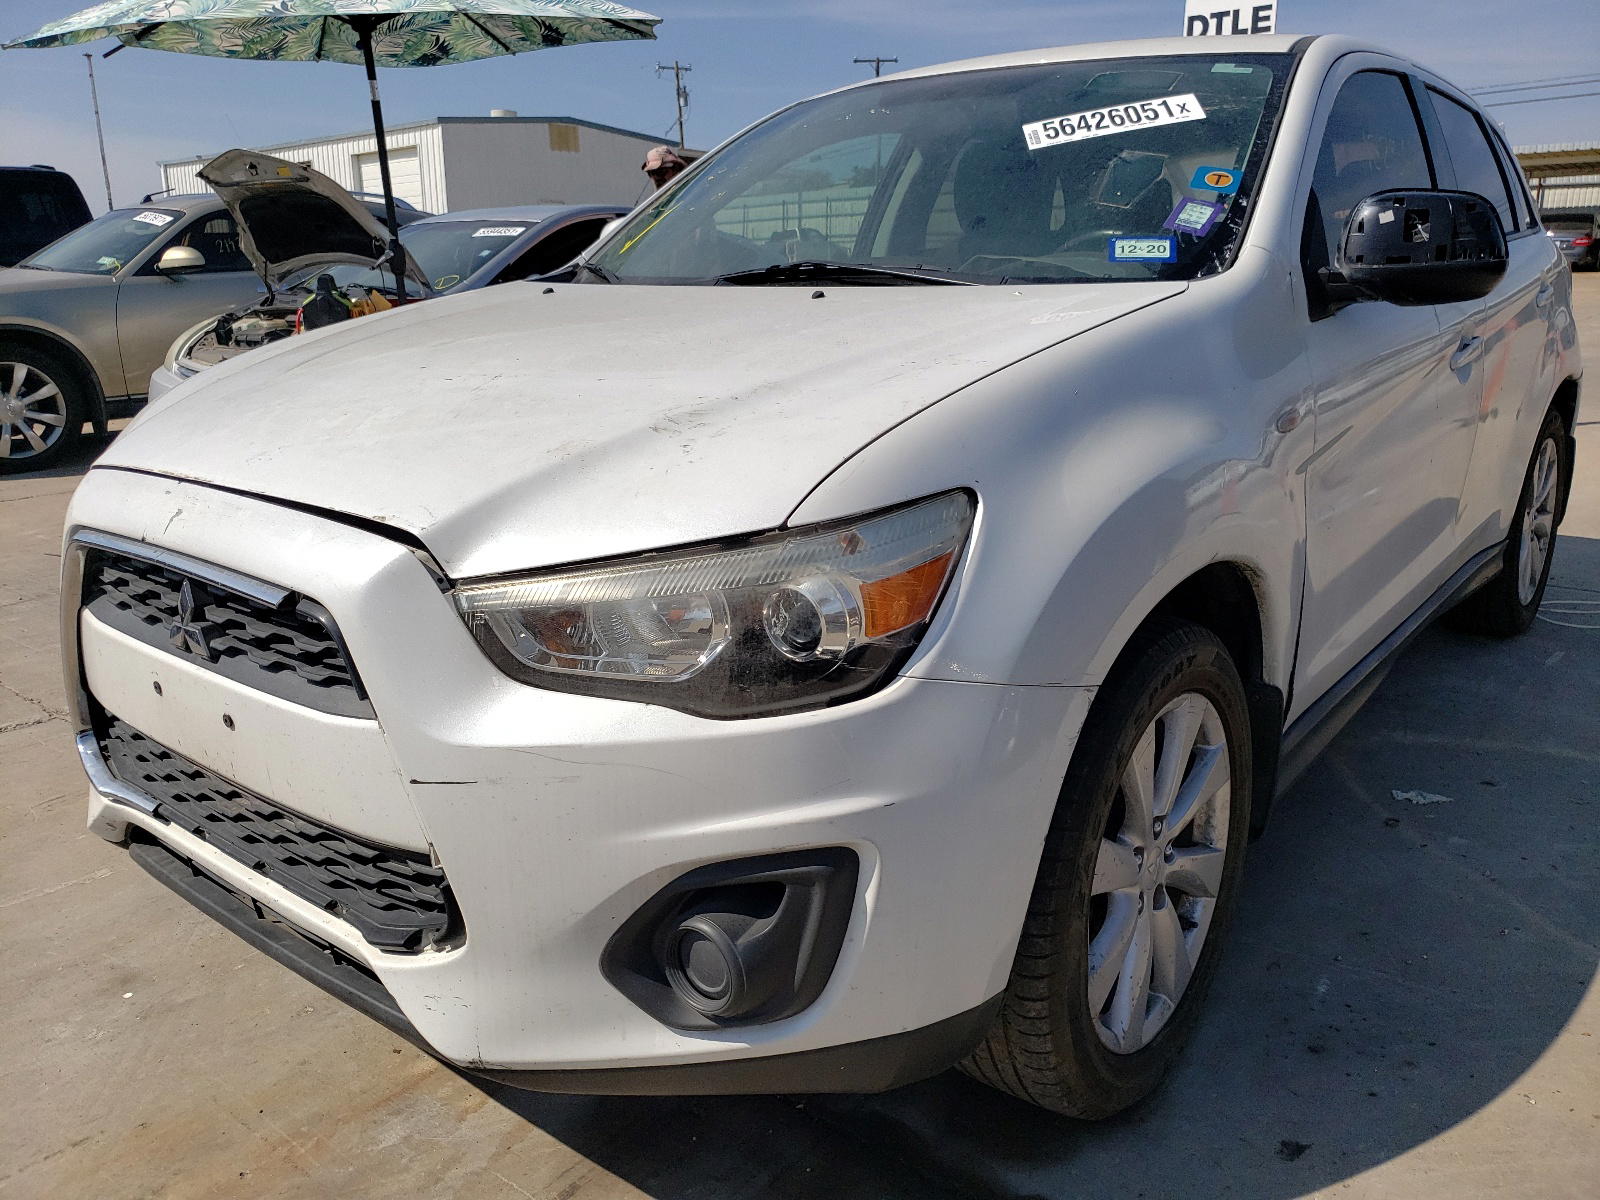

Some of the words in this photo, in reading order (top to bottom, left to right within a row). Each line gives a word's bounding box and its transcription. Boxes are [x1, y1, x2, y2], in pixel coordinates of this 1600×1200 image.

[1186, 4, 1273, 36] DTLE
[1042, 99, 1175, 140] 56426051
[1212, 173, 1229, 185] T
